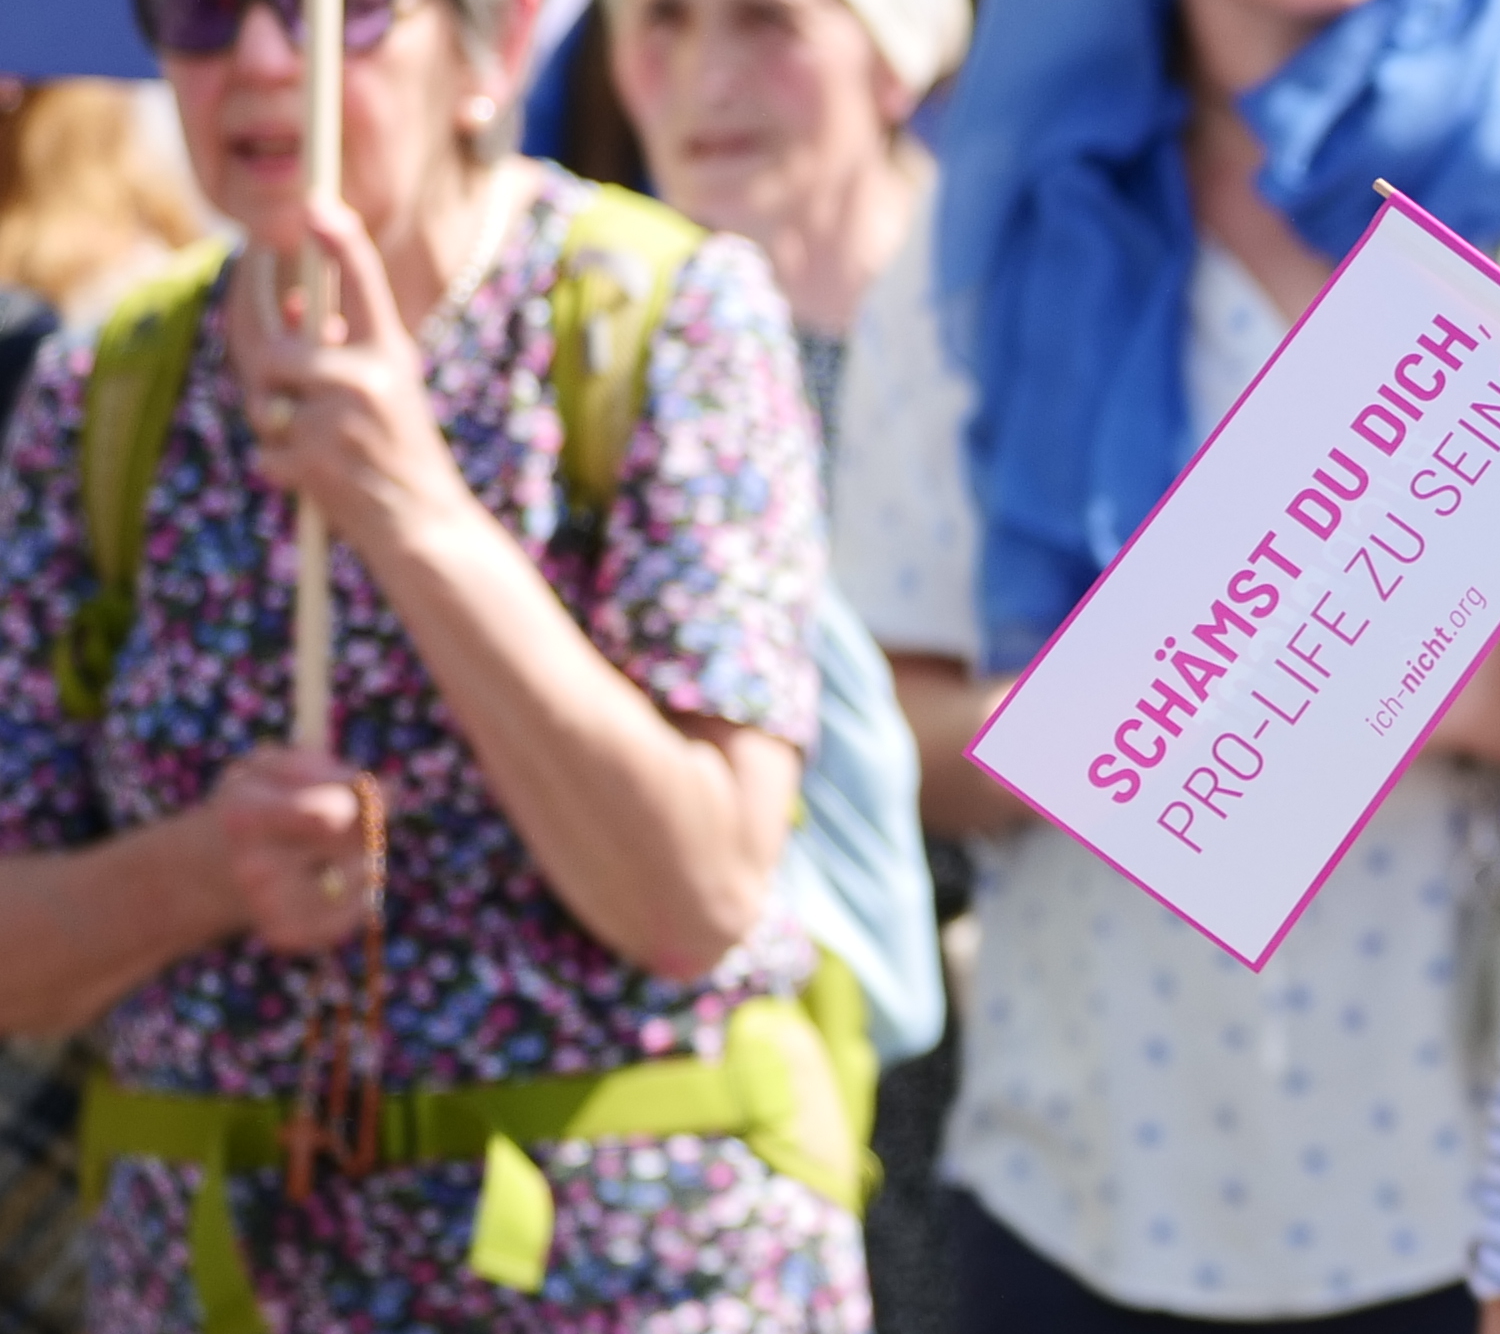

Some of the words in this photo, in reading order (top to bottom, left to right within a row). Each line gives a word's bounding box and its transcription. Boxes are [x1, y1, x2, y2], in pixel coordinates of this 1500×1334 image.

[1086, 529, 1304, 805] SCHÄMST
[1284, 446, 1371, 542] DU
[1349, 313, 1493, 457] DICH,
[1156, 590, 1371, 854] PRO-LIFE
[1344, 511, 1427, 602] ZU
[1364, 584, 1488, 737] ich-nicht.org
